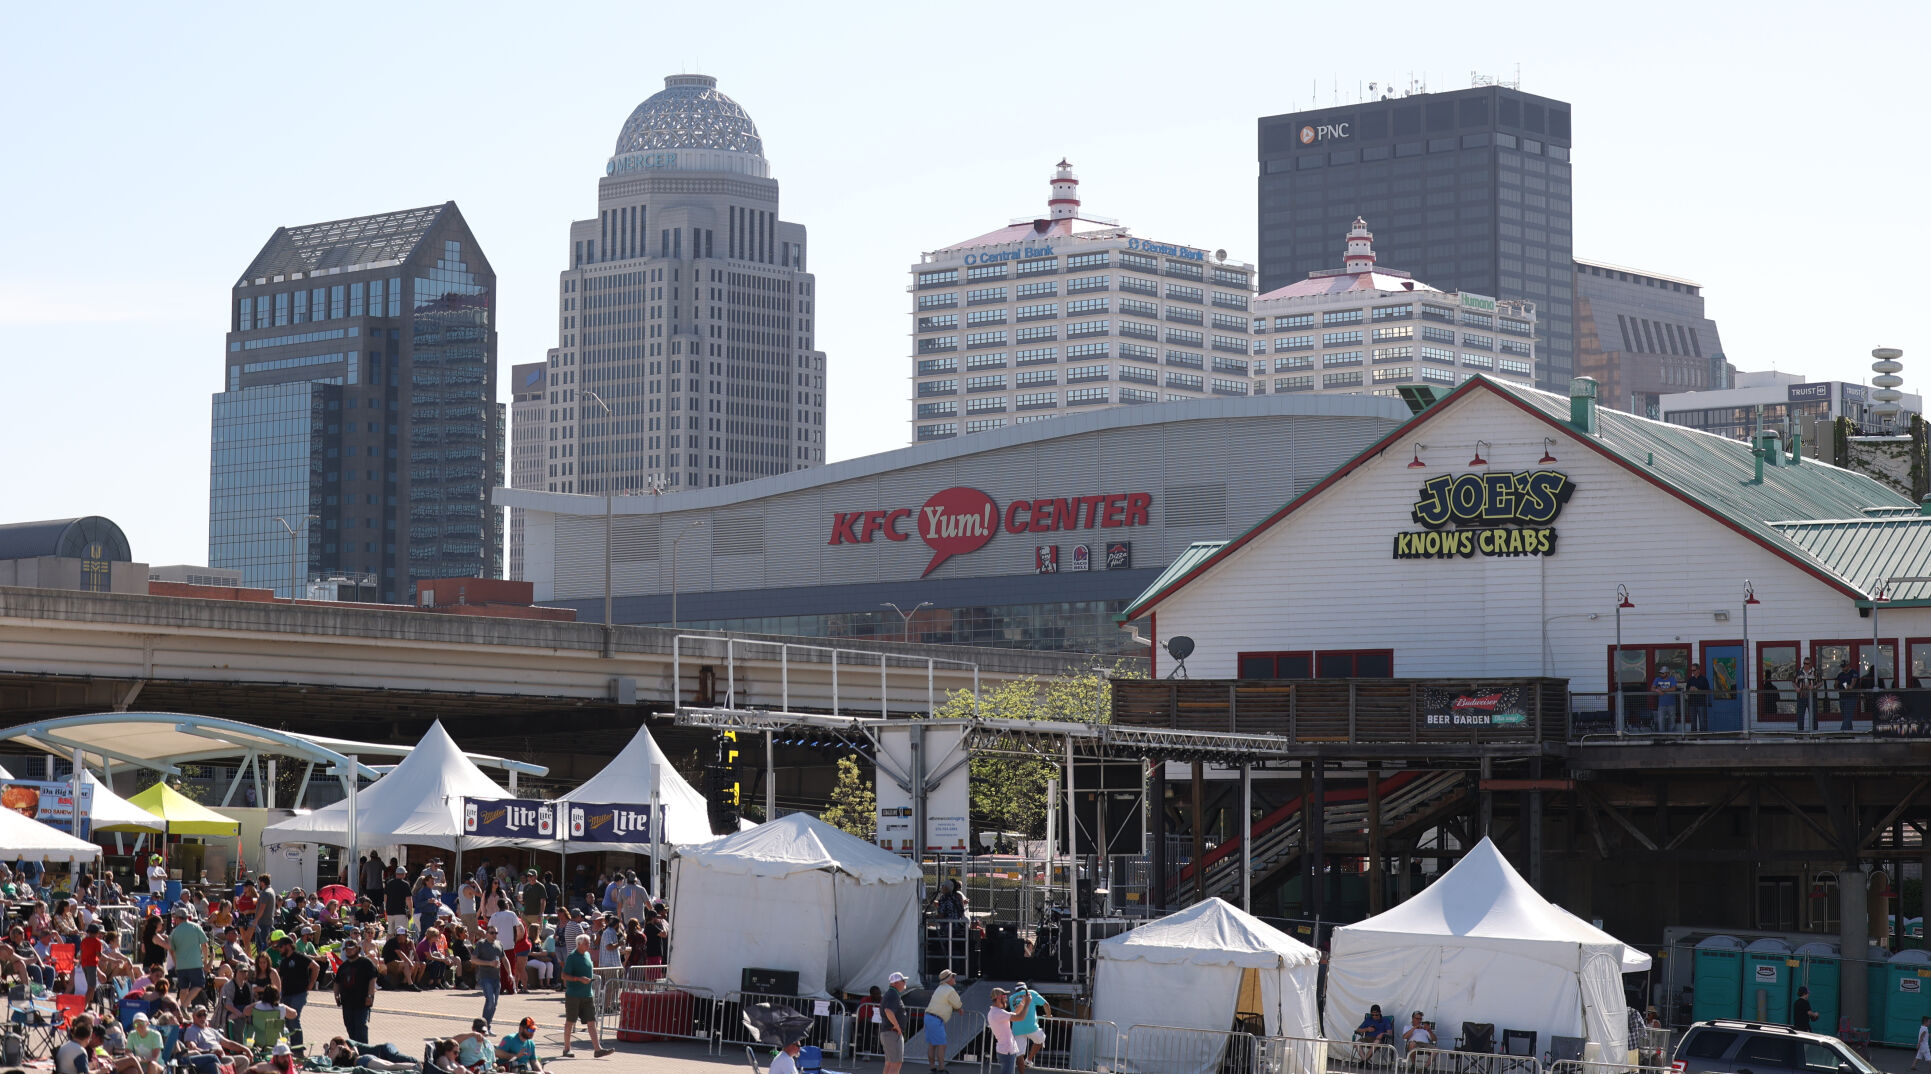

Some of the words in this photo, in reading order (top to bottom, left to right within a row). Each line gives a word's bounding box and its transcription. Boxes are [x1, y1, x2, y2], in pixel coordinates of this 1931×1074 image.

[1317, 123, 1349, 140] PNC
[617, 152, 677, 174] MERCER
[980, 251, 1021, 265] Central
[1024, 244, 1054, 259] Bank
[1142, 240, 1176, 256] Central
[1179, 247, 1204, 261] Bank
[1461, 294, 1494, 310] Humana
[1792, 386, 1816, 396] TRUIST
[1414, 471, 1568, 524] JOE'S
[827, 508, 911, 545] KFC
[924, 502, 991, 539] Yum!
[1004, 492, 1151, 534] CENTER
[1397, 530, 1474, 555] KNOWS
[1479, 528, 1551, 553] CRABS
[1456, 698, 1498, 707] Budweiser
[1427, 715, 1450, 724] BEER
[1454, 715, 1490, 724] GARDEN
[466, 808, 477, 817] Lite
[481, 808, 506, 824] Miller
[505, 805, 536, 831] Lite
[539, 811, 552, 820] Lite
[572, 813, 584, 822] Lite
[588, 813, 613, 829] Miller
[612, 809, 648, 836] Lite
